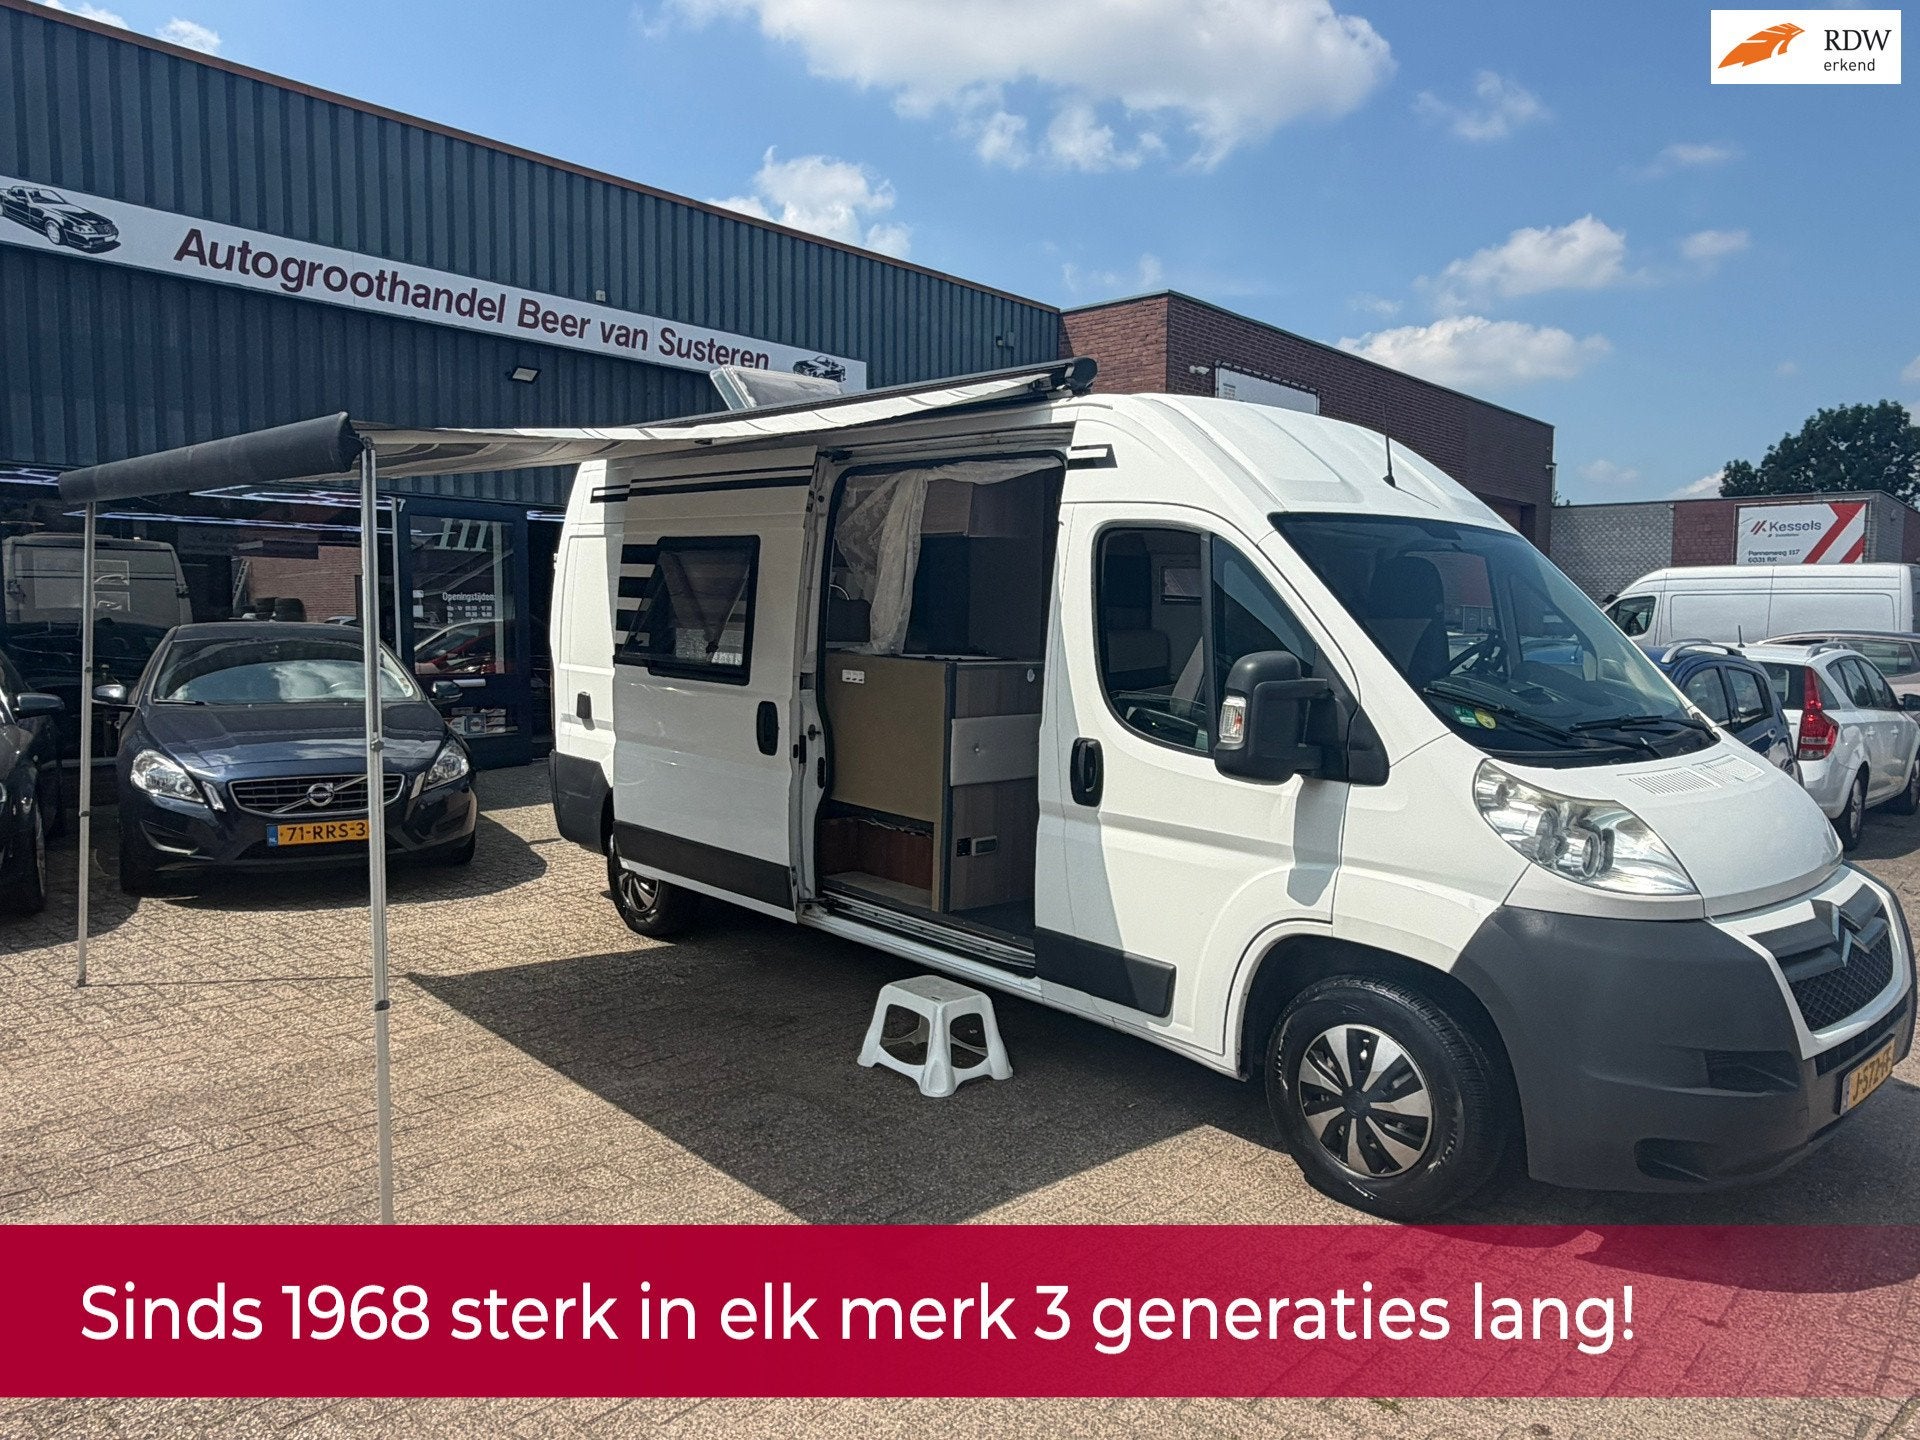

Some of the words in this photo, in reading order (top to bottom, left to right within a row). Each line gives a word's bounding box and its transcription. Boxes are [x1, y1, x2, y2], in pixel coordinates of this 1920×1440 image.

[174, 228, 507, 324] Autogroothandel
[517, 298, 592, 339] Beer
[600, 321, 649, 352] van
[658, 327, 769, 371] Susteren
[1769, 520, 1822, 532] Kessels
[287, 822, 366, 841] 71-RRS-3
